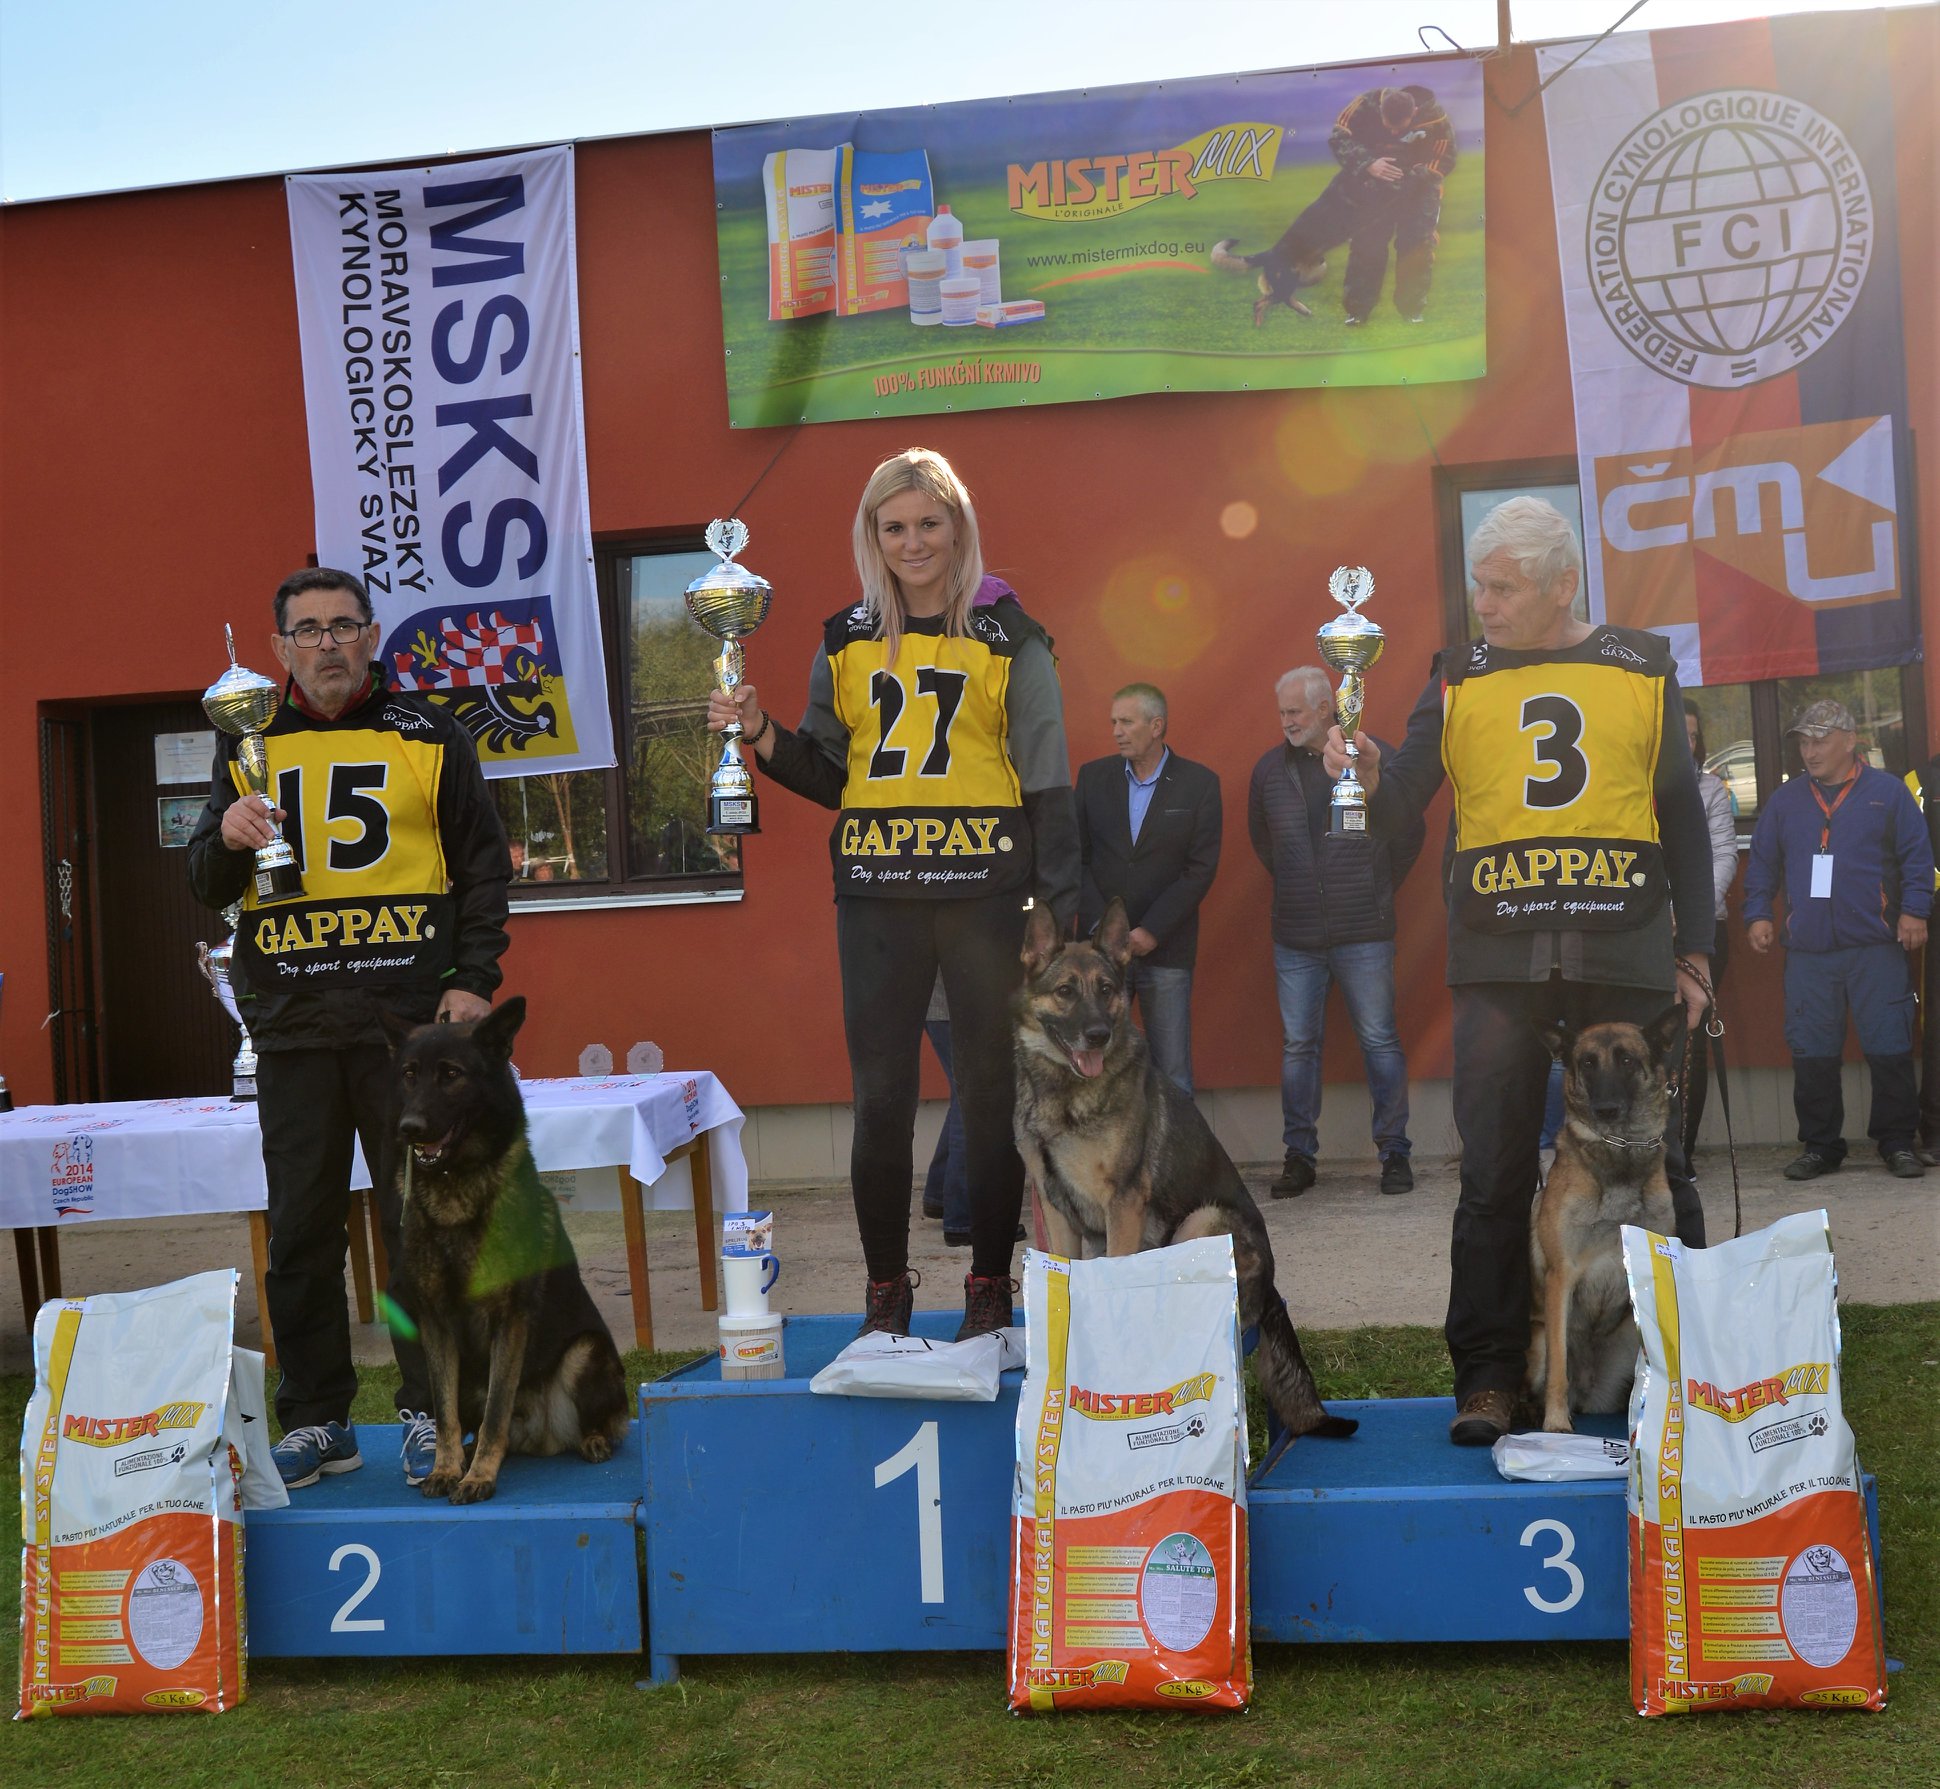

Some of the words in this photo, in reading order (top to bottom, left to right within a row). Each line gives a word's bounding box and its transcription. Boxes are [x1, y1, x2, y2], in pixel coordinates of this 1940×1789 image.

[1007, 150, 1199, 210] MISTER
[1191, 127, 1276, 179] MIX
[1603, 95, 1801, 203] CYNOLOGIQUE
[1055, 202, 1125, 219] L'ORIGINALE
[1027, 240, 1206, 268] www.mistermixdog.eu
[1785, 116, 1869, 358] INTERNATIONALE
[1594, 211, 1699, 376] FEDERATION
[338, 192, 387, 480] KYNOLOGICKÝ
[373, 188, 436, 594] MORAVSKOSLEZSKÝ
[422, 173, 549, 589] MSKS
[873, 371, 917, 398] 100%
[917, 357, 982, 390] FUNKČNÍ
[981, 361, 1042, 387] KRMIVO
[359, 493, 393, 595] SVAZ
[866, 665, 970, 782] 27
[1519, 692, 1591, 811] 3
[275, 761, 392, 874] 15
[840, 816, 1001, 857] GAPPAY
[850, 864, 873, 883] Dog
[877, 868, 912, 882] sport
[916, 866, 990, 885] equipment
[1471, 847, 1638, 895] GAPPAY
[1496, 900, 1519, 917] Dog
[1522, 899, 1557, 913] sport
[1562, 899, 1626, 915] equipment
[254, 904, 429, 956] GAPPAY
[276, 960, 300, 978] Dog
[304, 959, 341, 975] sport
[346, 954, 416, 973] equipment
[52, 1175, 94, 1187] EUROPEAN
[52, 1184, 93, 1196] DogSHOW
[66, 1162, 94, 1177] 2014
[1069, 1384, 1176, 1415] MISTER
[1171, 1374, 1213, 1405] MIX
[1687, 1377, 1789, 1414] MISTER
[1783, 1364, 1827, 1393] MIX
[63, 1413, 160, 1440] MISTER
[157, 1404, 203, 1427] MIX
[1037, 1389, 1064, 1493] SYSTEM
[1132, 1436, 1169, 1447] FUNZIONALE
[1135, 1428, 1181, 1441] ALIMENTAZIONE
[1660, 1380, 1683, 1500] SYSTEM
[1754, 1433, 1791, 1448] FUNZIONALE
[1755, 1421, 1801, 1441] ALIMENTAZIONE
[36, 1414, 59, 1523] SYSTEM
[118, 1460, 152, 1473] FUNZIONALE
[121, 1452, 164, 1467] ALIMENTAZIONE
[874, 1421, 945, 1604] 1
[1061, 1506, 1068, 1515] IL
[1069, 1503, 1095, 1515] PASTO
[1113, 1484, 1156, 1506] NATURALE
[1158, 1477, 1175, 1489] PER
[1176, 1475, 1186, 1485] IL
[1185, 1475, 1203, 1486] TUO
[1203, 1477, 1225, 1491] CANE
[1689, 1514, 1697, 1524] IL
[1699, 1512, 1727, 1525] PASTO
[1746, 1490, 1788, 1517] NATURALE
[1790, 1482, 1808, 1496] PER
[1808, 1479, 1817, 1489] IL
[1818, 1476, 1835, 1487] TUO
[54, 1534, 61, 1543] IL
[62, 1531, 83, 1543] PASTO
[98, 1510, 137, 1534] NATURALE
[139, 1503, 154, 1518] PER
[156, 1500, 164, 1510] IL
[164, 1499, 182, 1509] TUO
[182, 1499, 205, 1511] CANE
[1034, 1510, 1052, 1662] NATURAL
[1166, 1564, 1195, 1573] SALUTE
[1197, 1566, 1211, 1574] TOP
[1519, 1518, 1585, 1614] 3
[34, 1537, 51, 1679] NATURAL
[328, 1543, 385, 1633] 2
[1662, 1517, 1686, 1675] NATURAL
[27, 1682, 89, 1702] MISTER
[1025, 1667, 1097, 1689] MISTER
[1093, 1663, 1123, 1682] MIX
[1168, 1684, 1183, 1695] 25
[1185, 1684, 1203, 1697] Kg
[1659, 1679, 1736, 1699] MISTER
[1735, 1675, 1770, 1695] MIX
[153, 1694, 167, 1704] 25
[168, 1694, 185, 1707] Kg
[1813, 1693, 1828, 1702] 25
[1831, 1693, 1850, 1704] Kg
